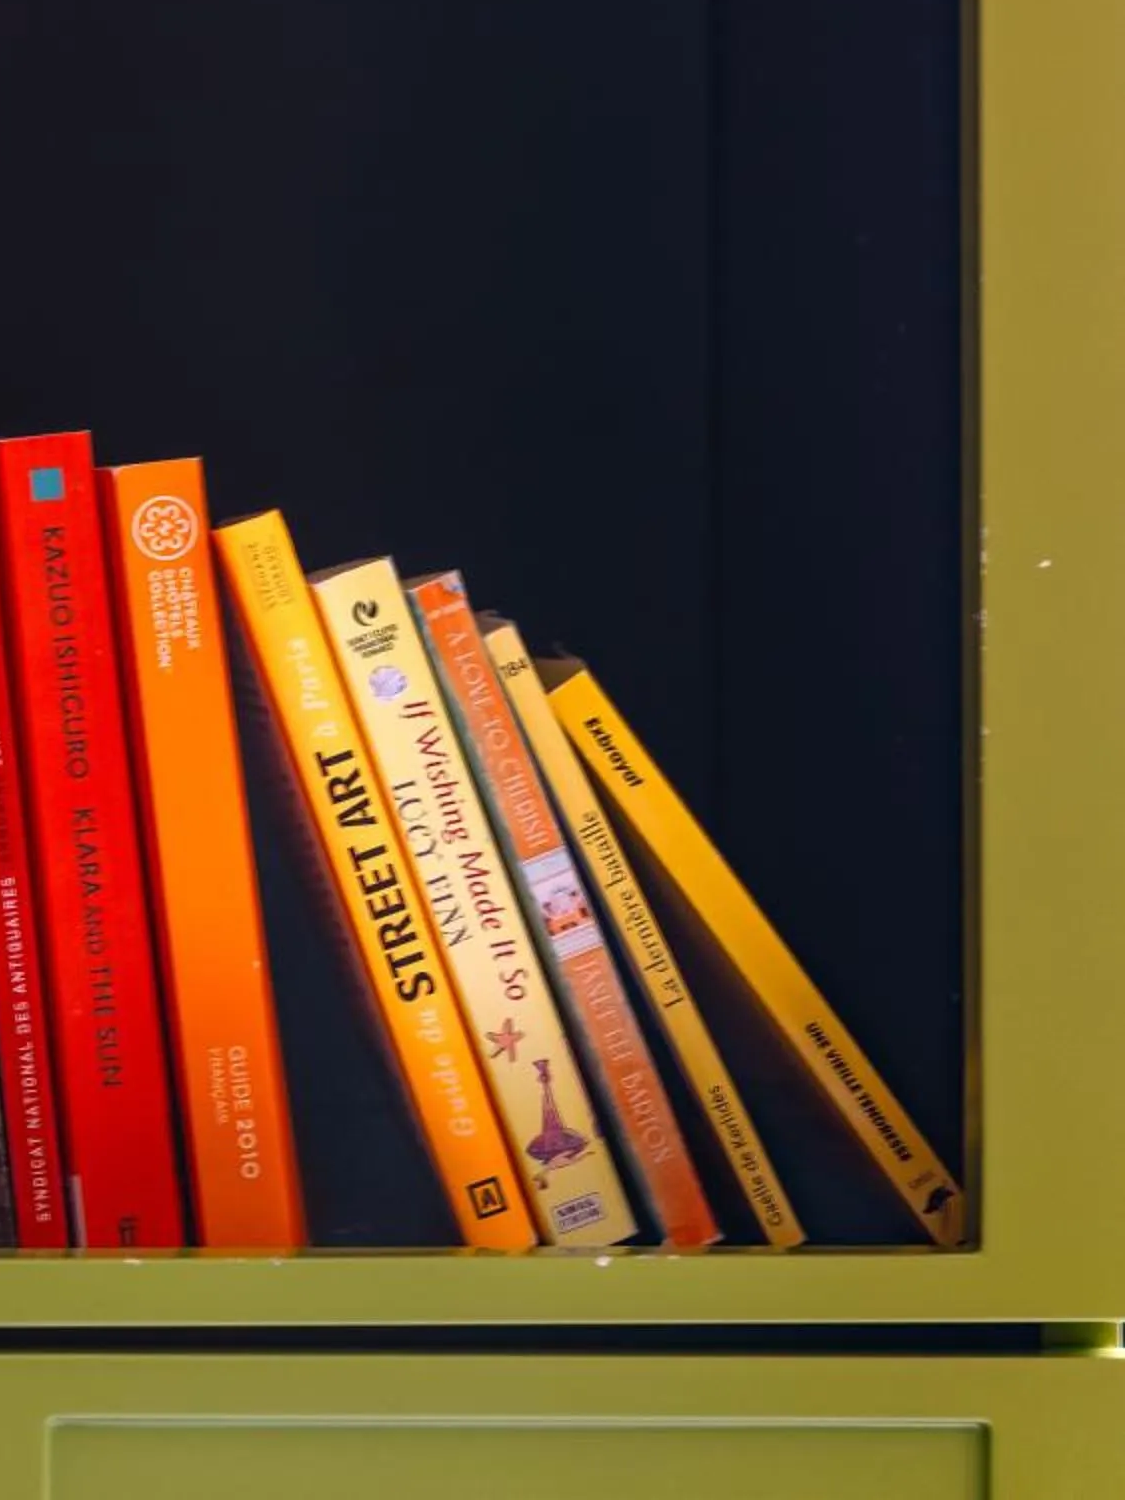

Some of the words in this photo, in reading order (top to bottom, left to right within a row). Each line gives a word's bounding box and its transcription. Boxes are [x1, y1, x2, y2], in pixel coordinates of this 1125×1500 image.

[41, 524, 74, 626] KAZUO
[52, 634, 90, 779] ISHIGURO
[286, 636, 329, 714] Paris
[395, 696, 435, 727] If
[453, 649, 496, 711] LOVE
[481, 714, 512, 753] TO
[313, 747, 378, 834] ART
[390, 777, 443, 866] LUCY
[407, 724, 476, 846] Wishing
[71, 807, 102, 897] KLARA
[457, 845, 509, 933] Made
[571, 808, 629, 890] bataille
[83, 904, 106, 955] AND
[350, 837, 437, 1003] STREET
[489, 935, 519, 961] It
[12, 1000, 31, 1035] DES
[88, 966, 114, 1017] THE
[498, 965, 535, 1003] So
[653, 976, 686, 1010] La
[96, 1025, 122, 1087] SUN
[409, 1005, 447, 1048] du
[16, 1040, 42, 1129] NATIONAL
[226, 1044, 253, 1112] GUIDE
[429, 1051, 476, 1141] Guide
[27, 1135, 52, 1222] SYNDICAT
[233, 1118, 261, 1180] 2010
[733, 1149, 759, 1176] de
